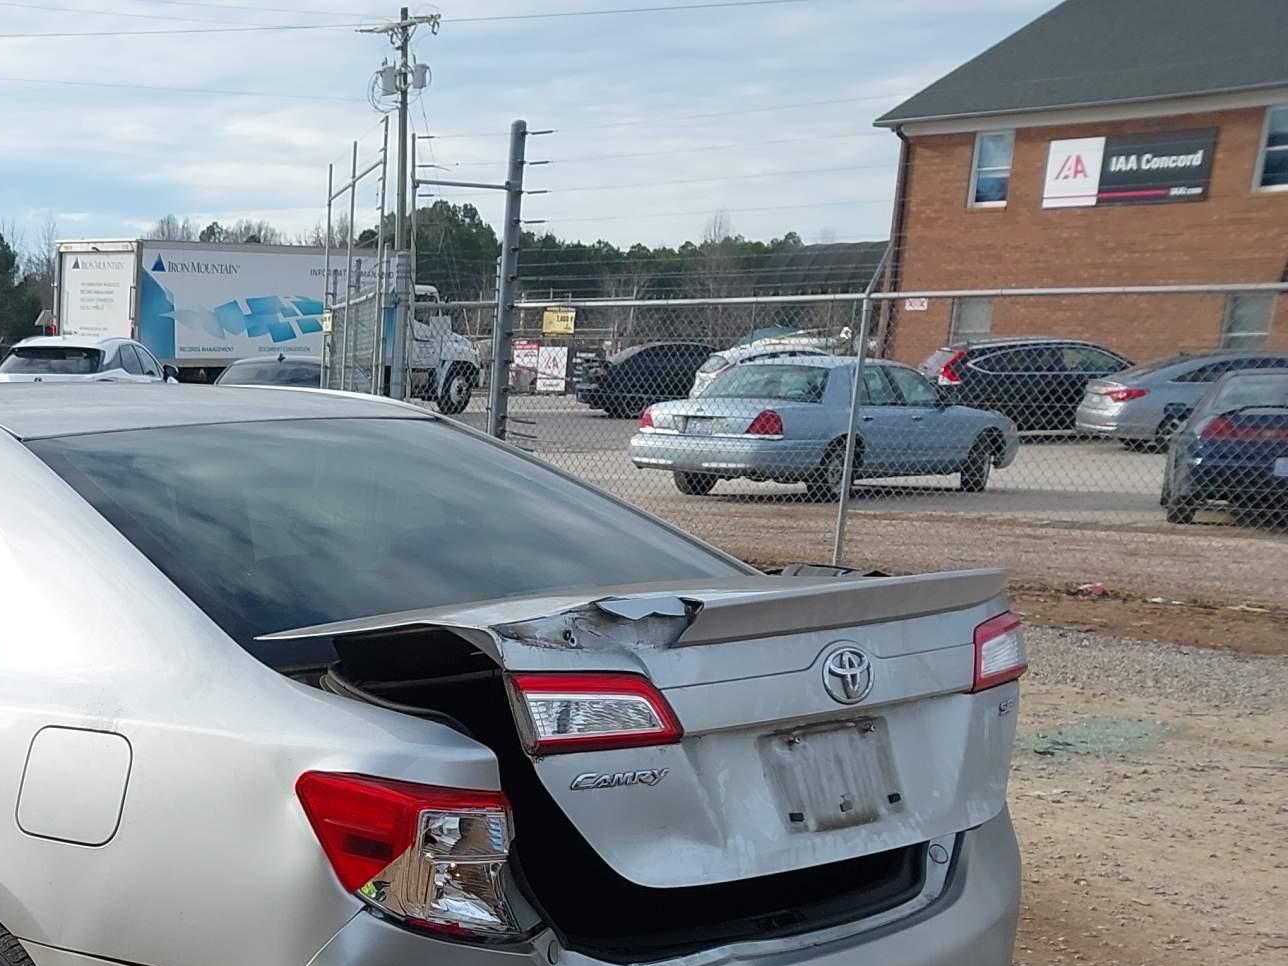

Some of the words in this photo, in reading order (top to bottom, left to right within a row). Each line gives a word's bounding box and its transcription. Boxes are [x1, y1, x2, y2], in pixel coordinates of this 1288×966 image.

[1110, 155, 1137, 171] IAA
[1141, 149, 1203, 169] Concord
[168, 260, 190, 273] IRON
[191, 261, 238, 275] MOUNTAIN
